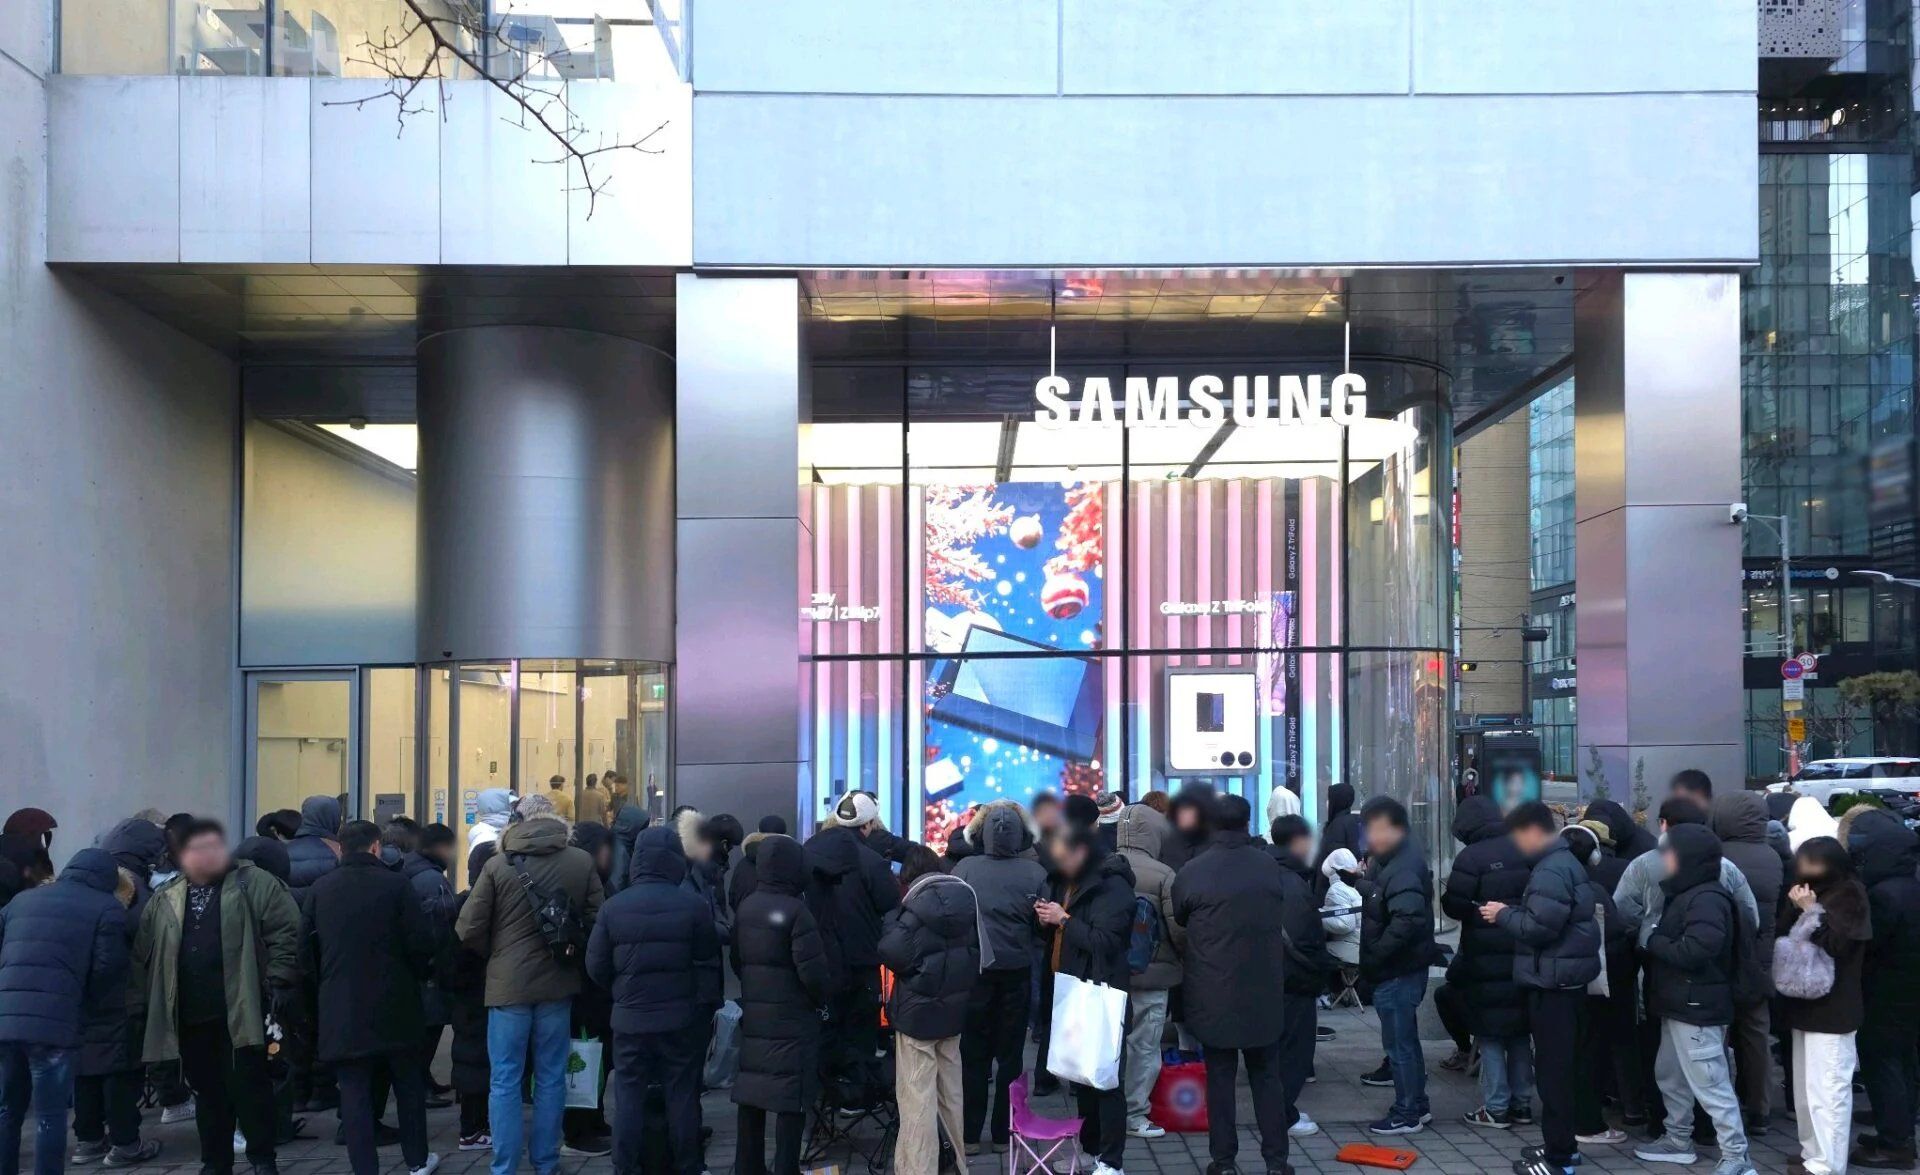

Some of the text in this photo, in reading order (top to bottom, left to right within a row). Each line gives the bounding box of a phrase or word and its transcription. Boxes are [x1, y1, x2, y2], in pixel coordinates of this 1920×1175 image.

[1035, 373, 1367, 430] SAMSUNG
[1289, 551, 1297, 579] Galaxy
[1160, 602, 1211, 616] Galaxy
[1212, 601, 1220, 613] Z
[1801, 658, 1813, 667] 30
[1289, 749, 1298, 778] Galaxy
